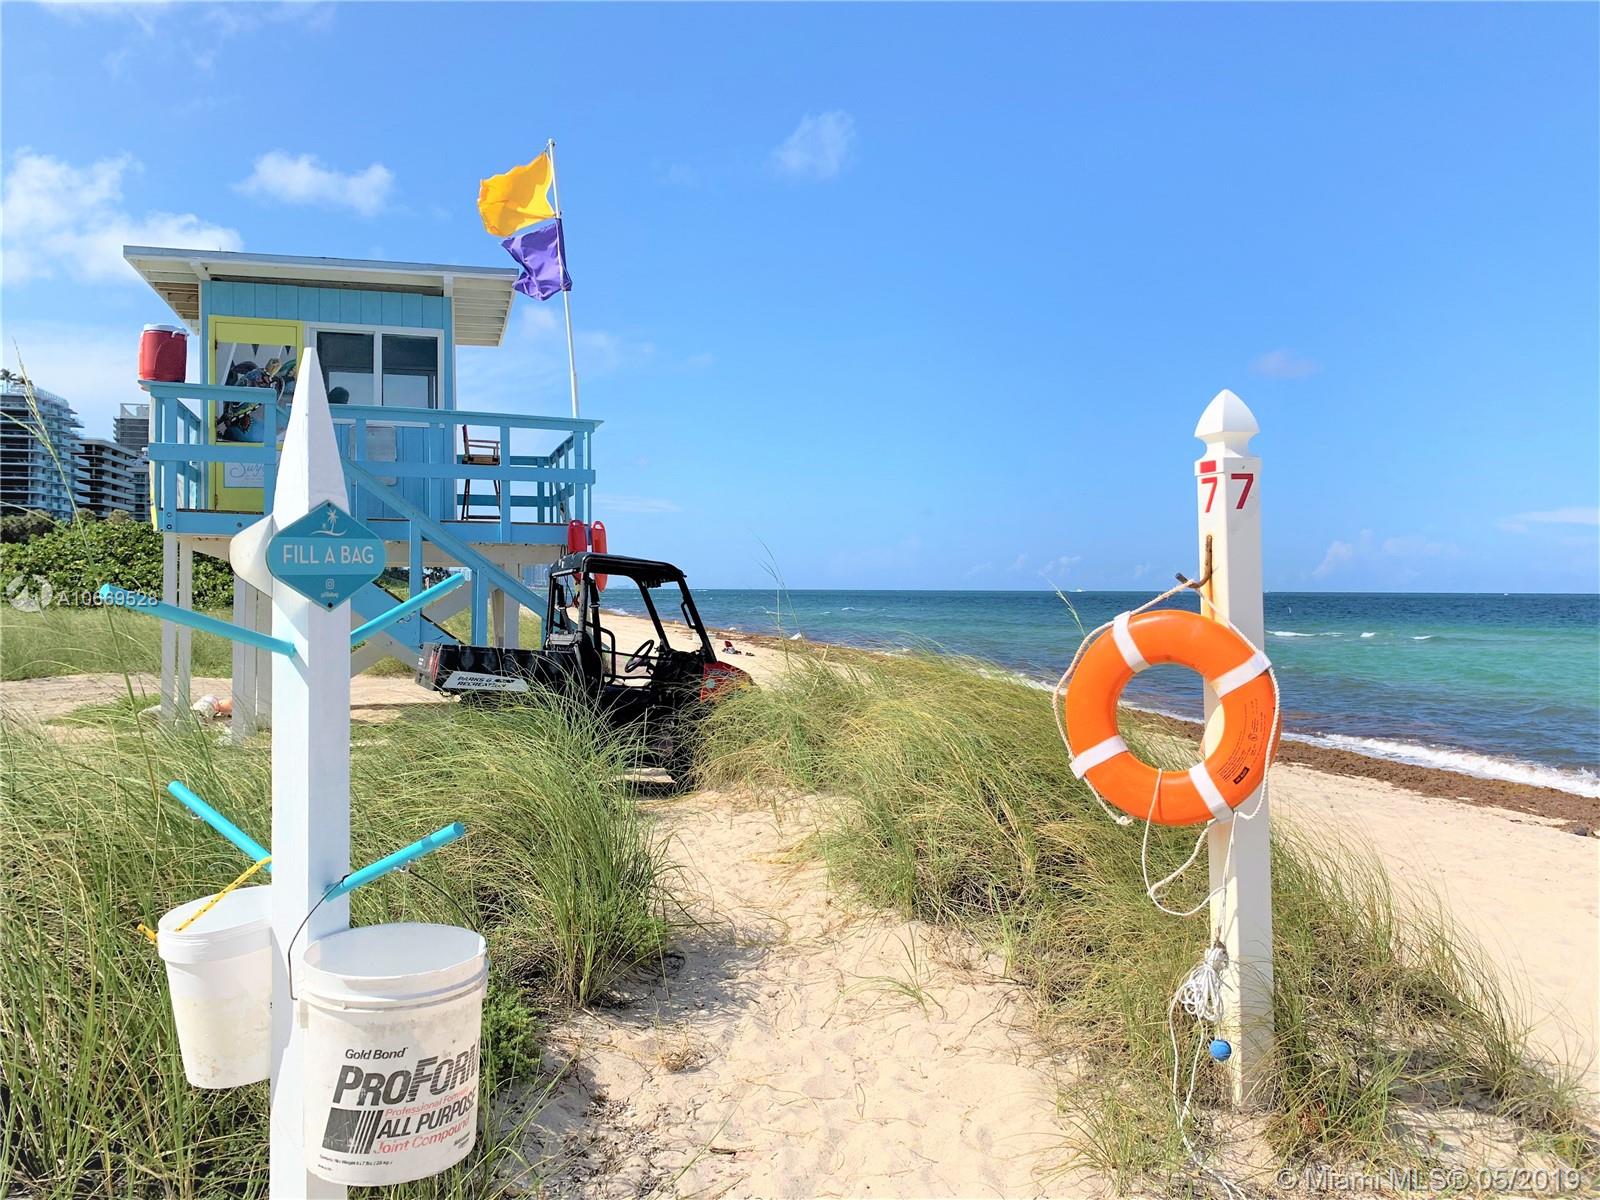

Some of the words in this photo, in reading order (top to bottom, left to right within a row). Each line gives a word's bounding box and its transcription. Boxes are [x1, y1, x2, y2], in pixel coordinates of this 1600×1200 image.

[1201, 476, 1217, 513] 7
[1231, 473, 1254, 509] 7
[283, 544, 319, 564] FILL
[324, 545, 336, 564] A
[341, 545, 374, 564] BAG
[345, 1048, 371, 1060] Gold
[372, 1047, 405, 1060] Bond
[384, 1097, 442, 1117] Professional
[376, 1117, 412, 1139] ALL
[377, 1140, 410, 1154] Joint
[411, 1117, 470, 1149] Compound
